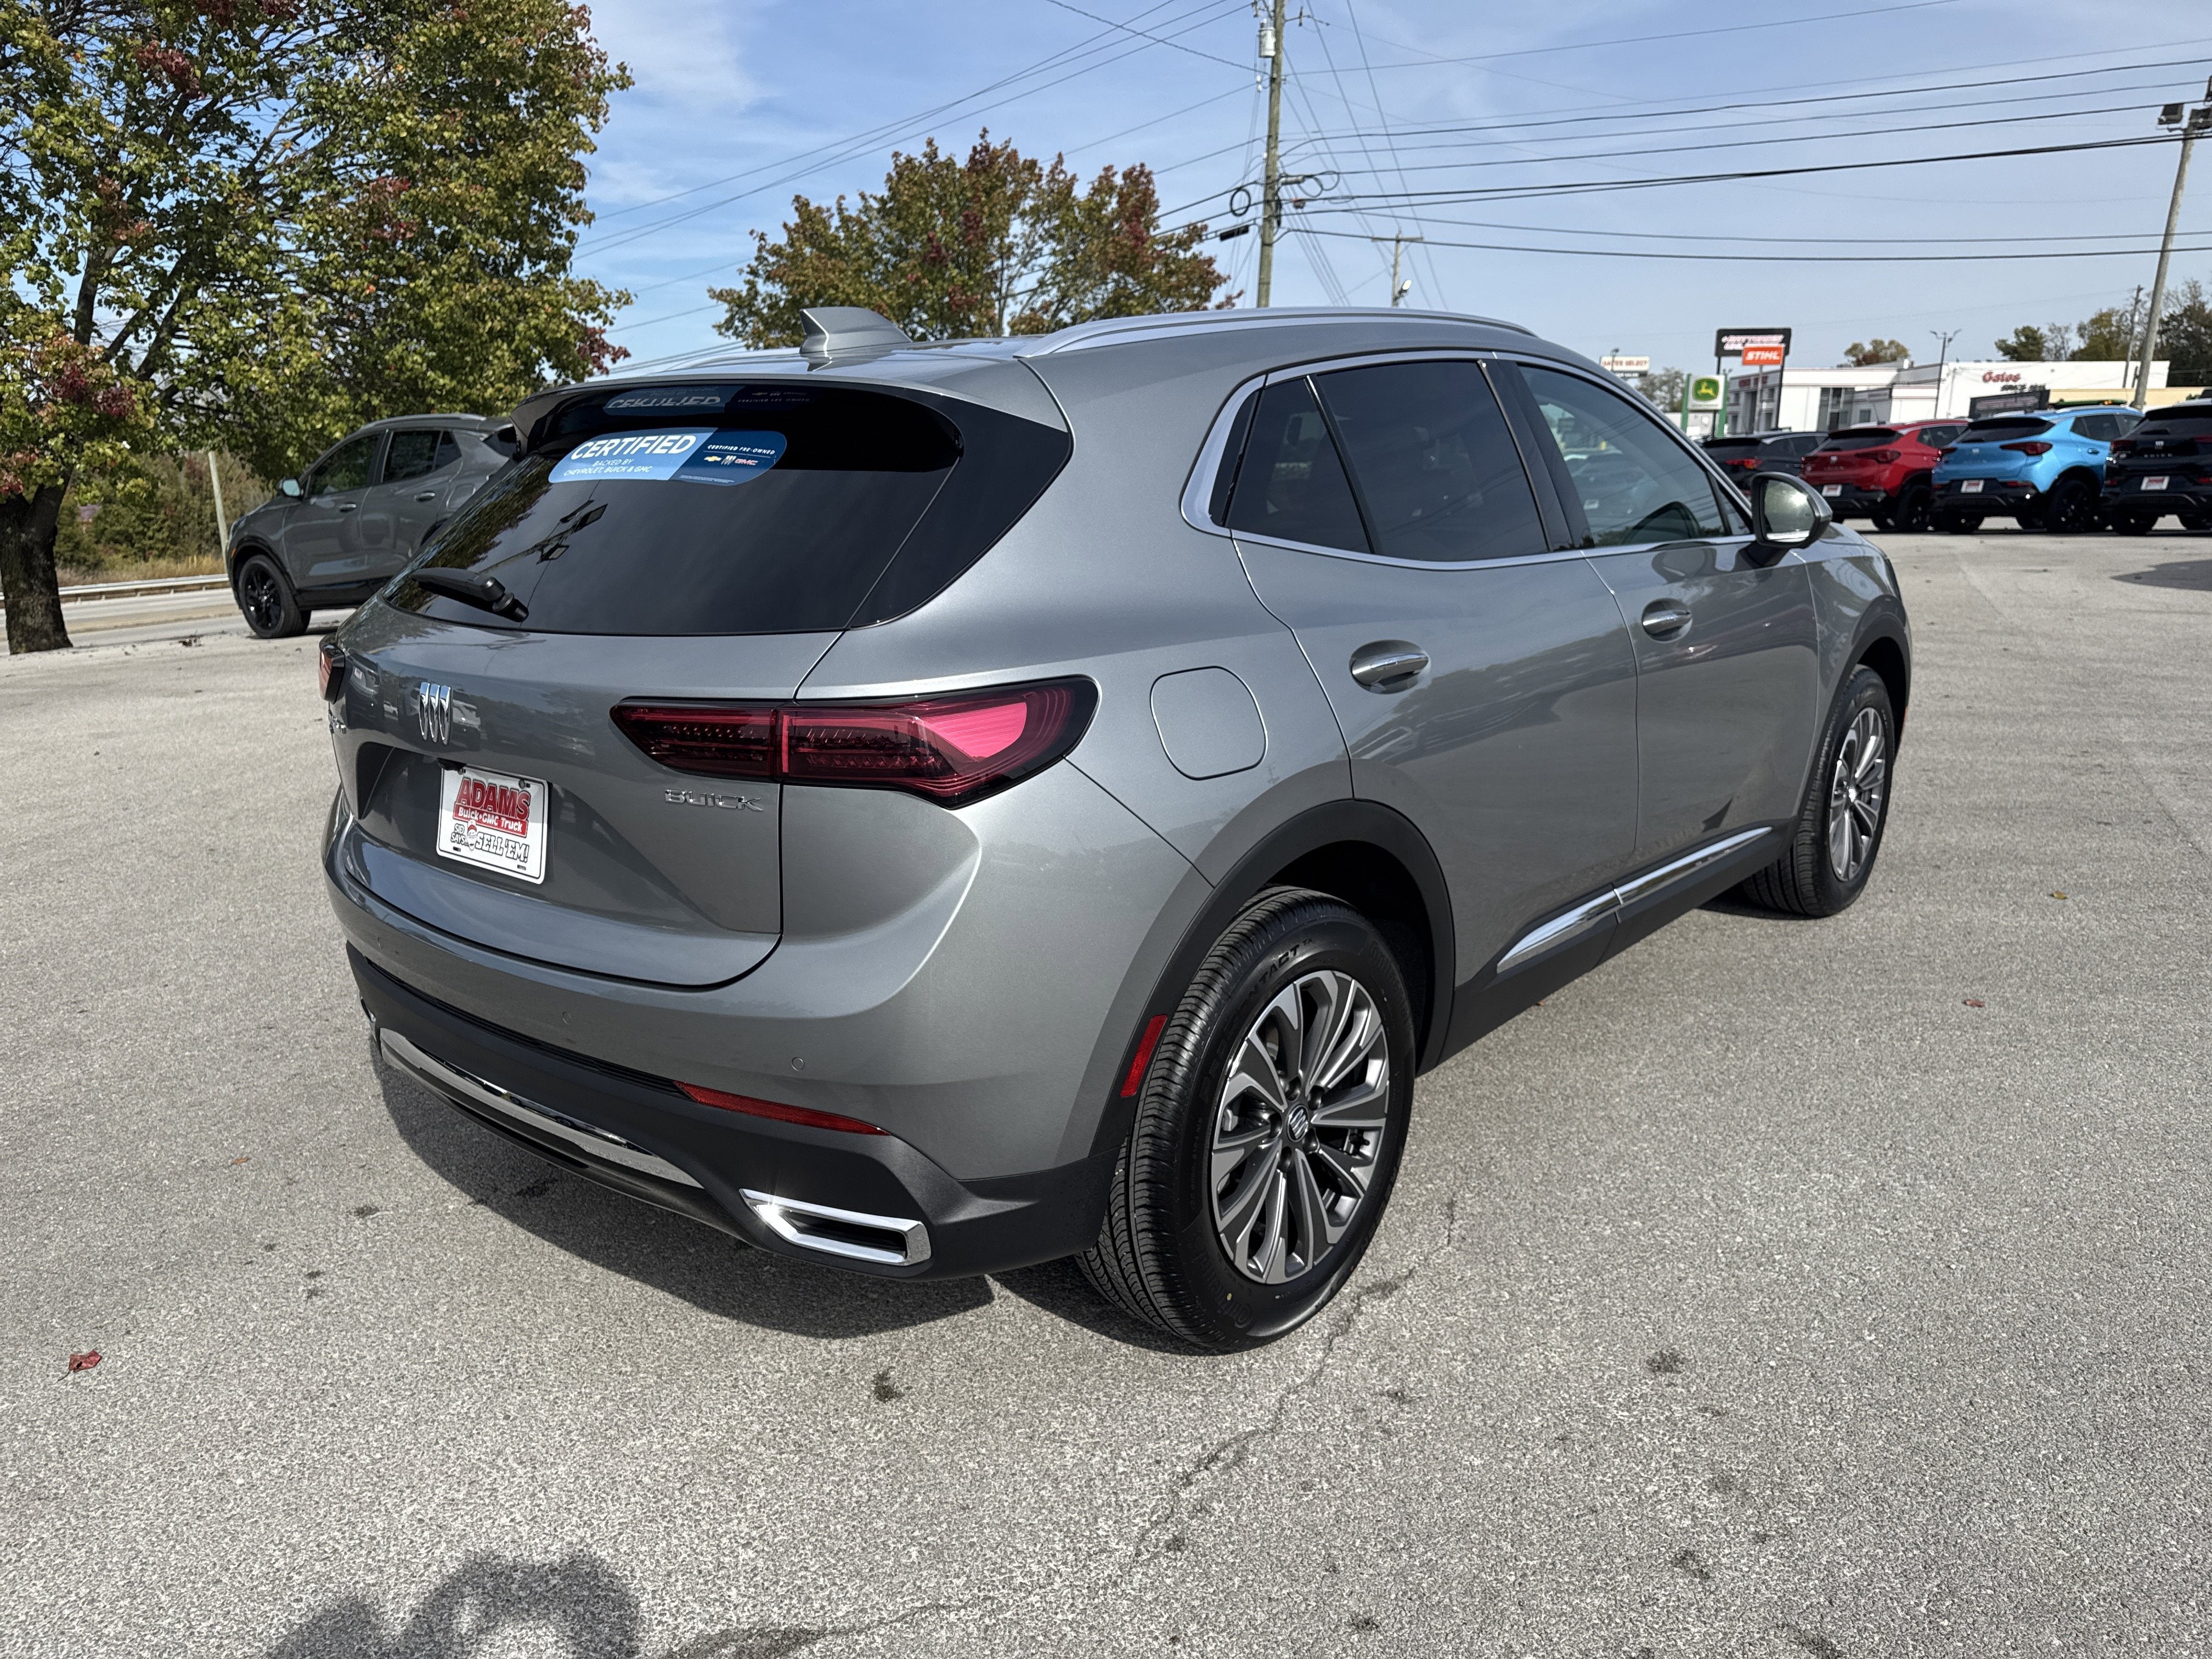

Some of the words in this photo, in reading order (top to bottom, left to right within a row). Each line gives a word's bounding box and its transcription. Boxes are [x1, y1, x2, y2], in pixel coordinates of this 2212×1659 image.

[1745, 351, 1780, 360] STIHL
[571, 435, 696, 460] CERTIFIED
[739, 447, 775, 455] PRE-OWNED
[456, 778, 531, 820] ADAMS
[665, 789, 764, 811] BUICK
[454, 823, 465, 833] SID
[500, 816, 523, 833] Truck
[475, 831, 504, 856] SELL
